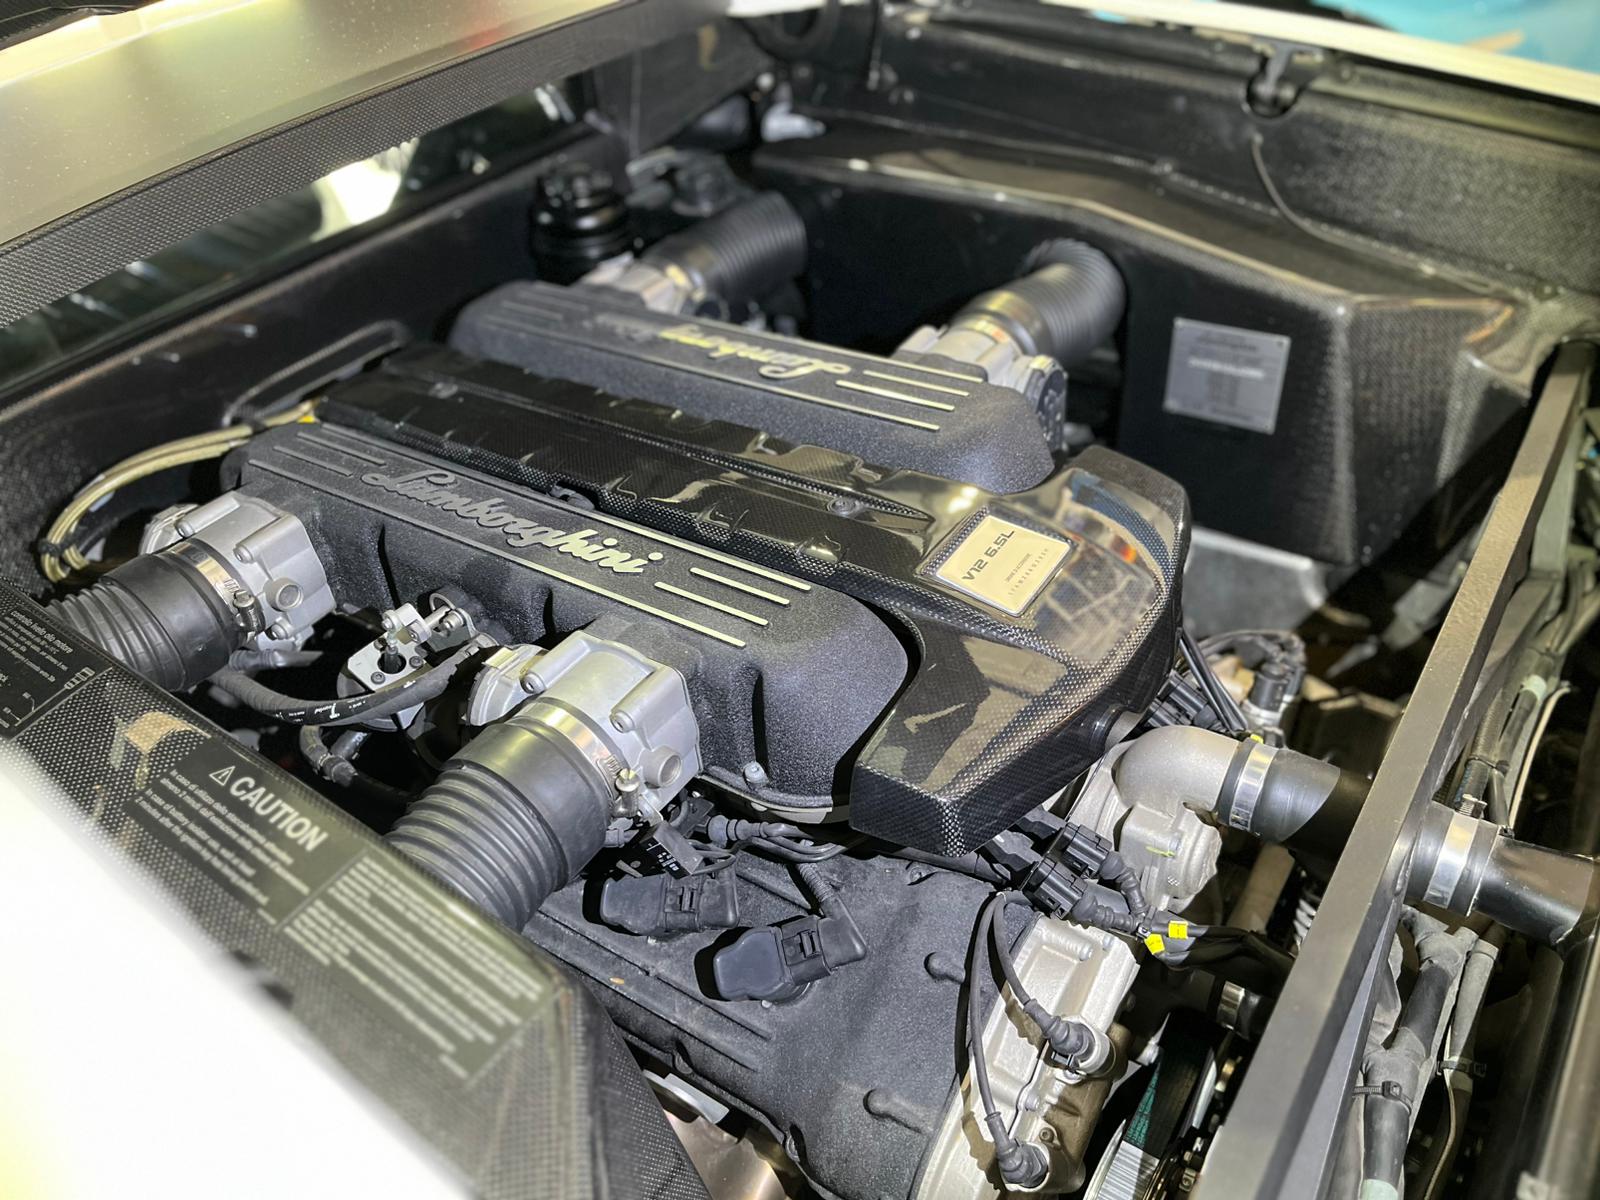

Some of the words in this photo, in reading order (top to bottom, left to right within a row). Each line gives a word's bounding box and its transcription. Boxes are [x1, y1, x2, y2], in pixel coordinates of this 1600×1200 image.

[361, 469, 664, 573] Lamborghini
[962, 558, 989, 581] V12
[984, 530, 1015, 557] 6.5L
[150, 794, 165, 806] case
[169, 808, 190, 826] battery
[230, 776, 329, 852] CAUTION
